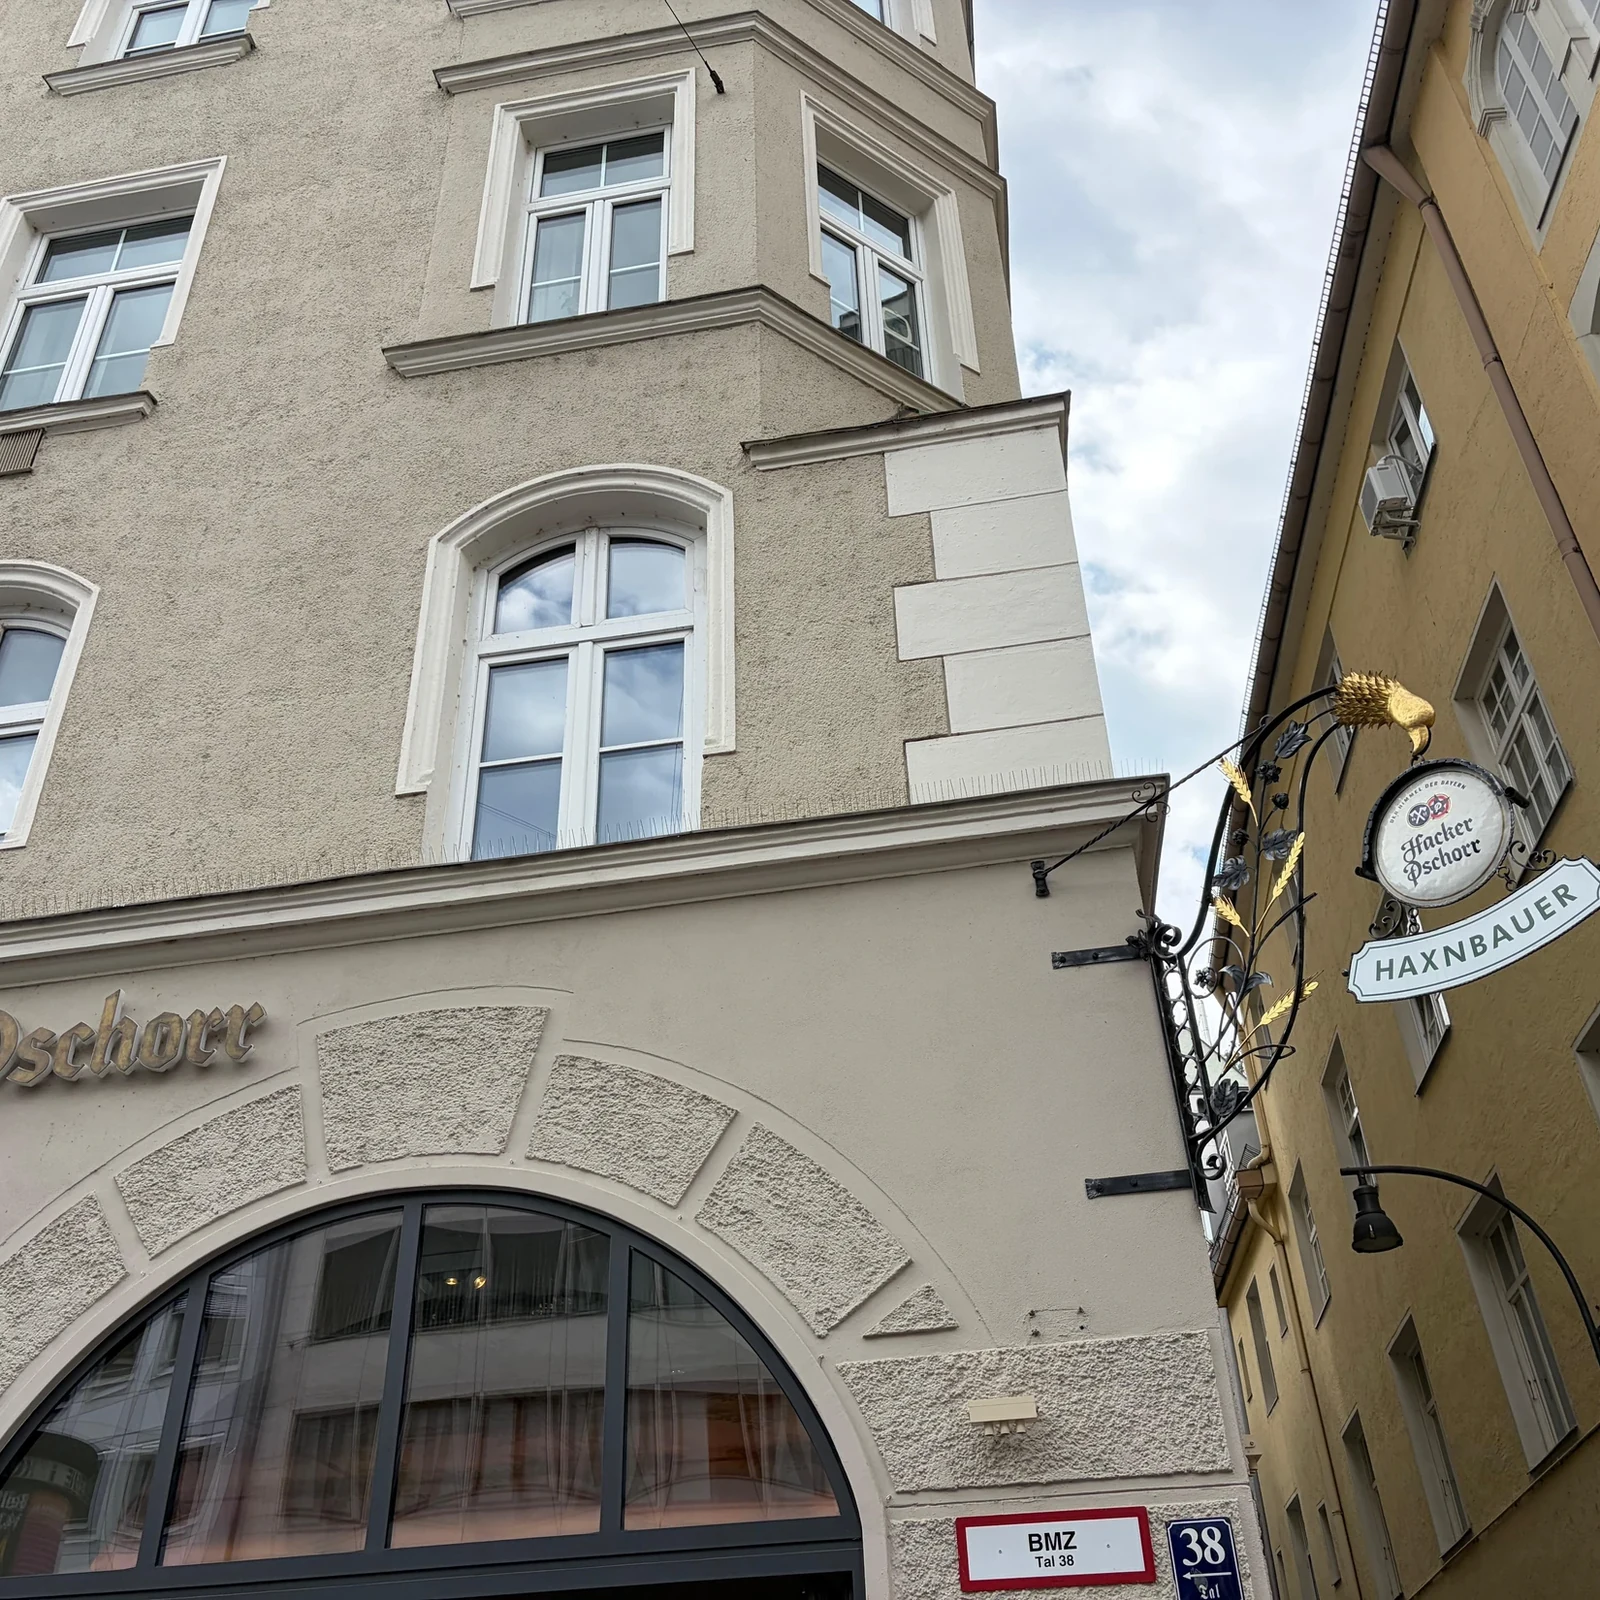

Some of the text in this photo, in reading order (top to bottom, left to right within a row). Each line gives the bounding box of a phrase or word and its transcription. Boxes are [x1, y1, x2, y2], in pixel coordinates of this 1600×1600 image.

[1398, 787, 1422, 810] HIMMEL
[1424, 780, 1439, 789] DER
[1440, 779, 1467, 790] BAYERN
[1400, 817, 1474, 863] Hacker
[1402, 838, 1482, 888] Pschorr
[1375, 883, 1578, 982] HAXNBAUER
[0, 988, 268, 1088] schorr
[1027, 1531, 1078, 1553] BMZ
[1034, 1554, 1075, 1569] Tal 38
[1179, 1526, 1226, 1567] 38
[1198, 1583, 1221, 1600] Tal
